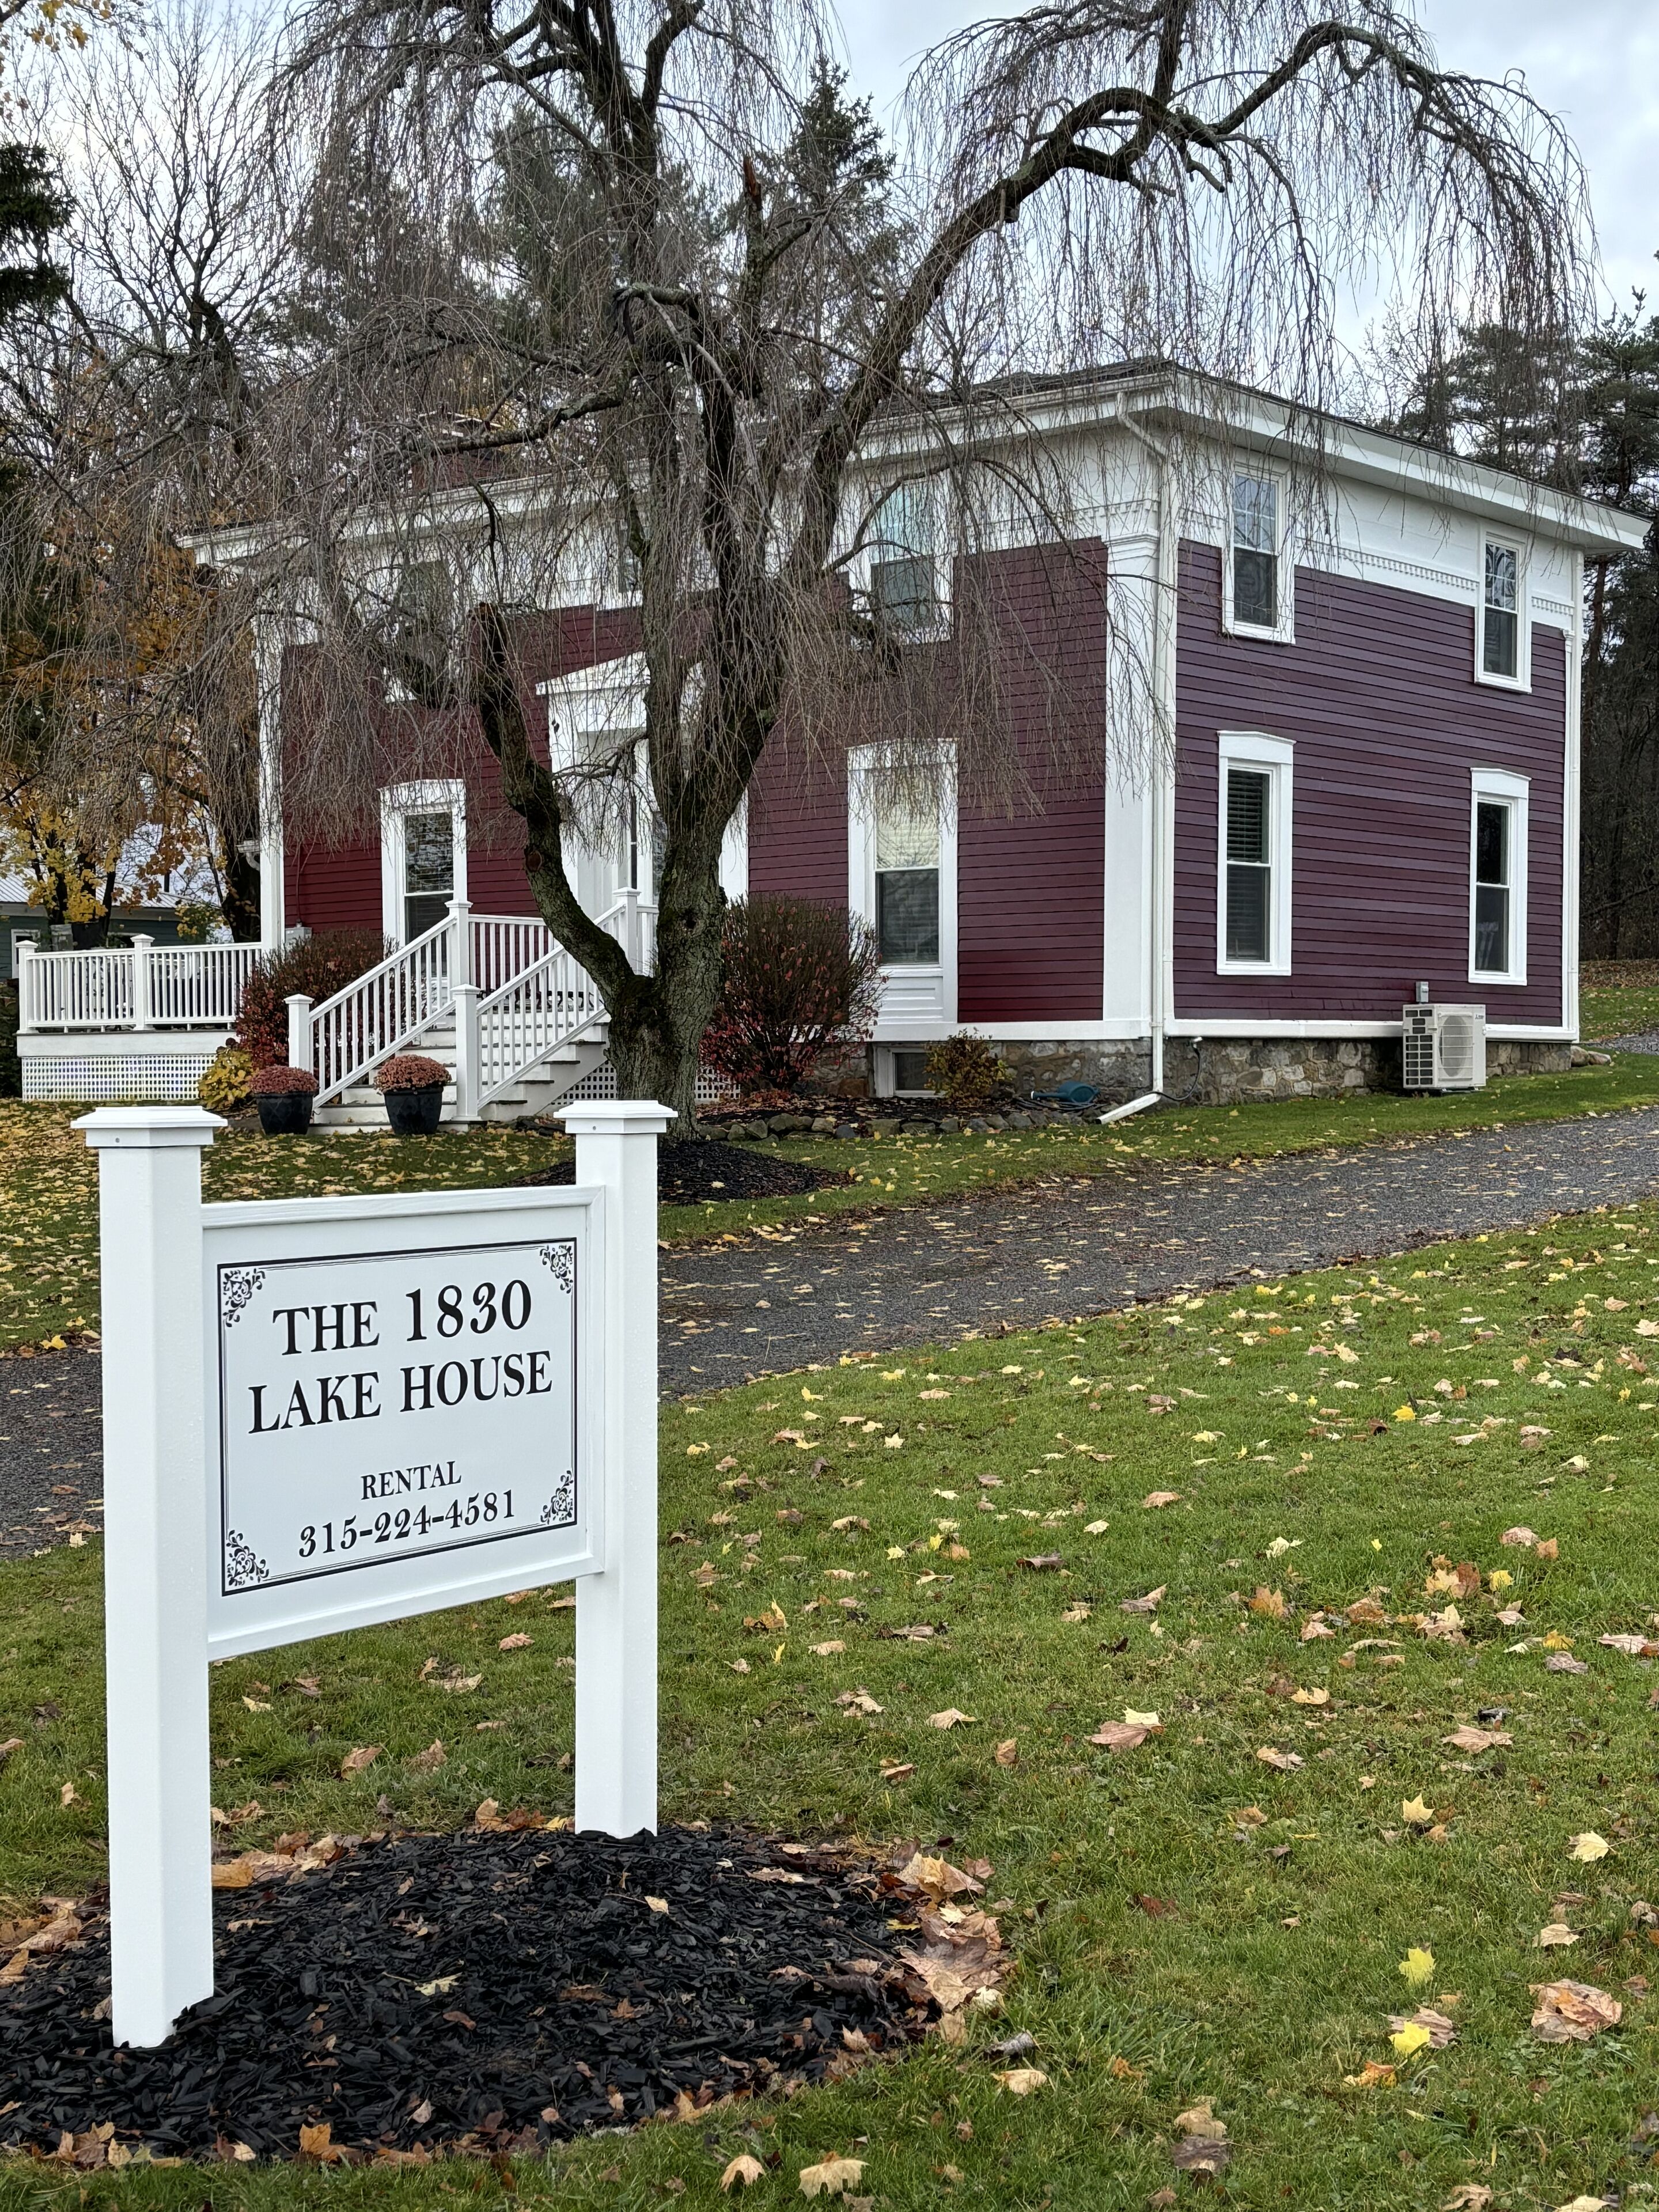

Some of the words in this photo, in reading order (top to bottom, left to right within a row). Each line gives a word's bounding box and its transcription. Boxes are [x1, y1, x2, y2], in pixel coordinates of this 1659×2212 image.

[272, 1301, 380, 1356] THE
[406, 1279, 532, 1342] 1830
[248, 1372, 381, 1434] LAKE
[400, 1350, 552, 1412] HOUSE
[361, 1461, 461, 1500] RENTAL
[299, 1489, 514, 1558] 315-224-4581
